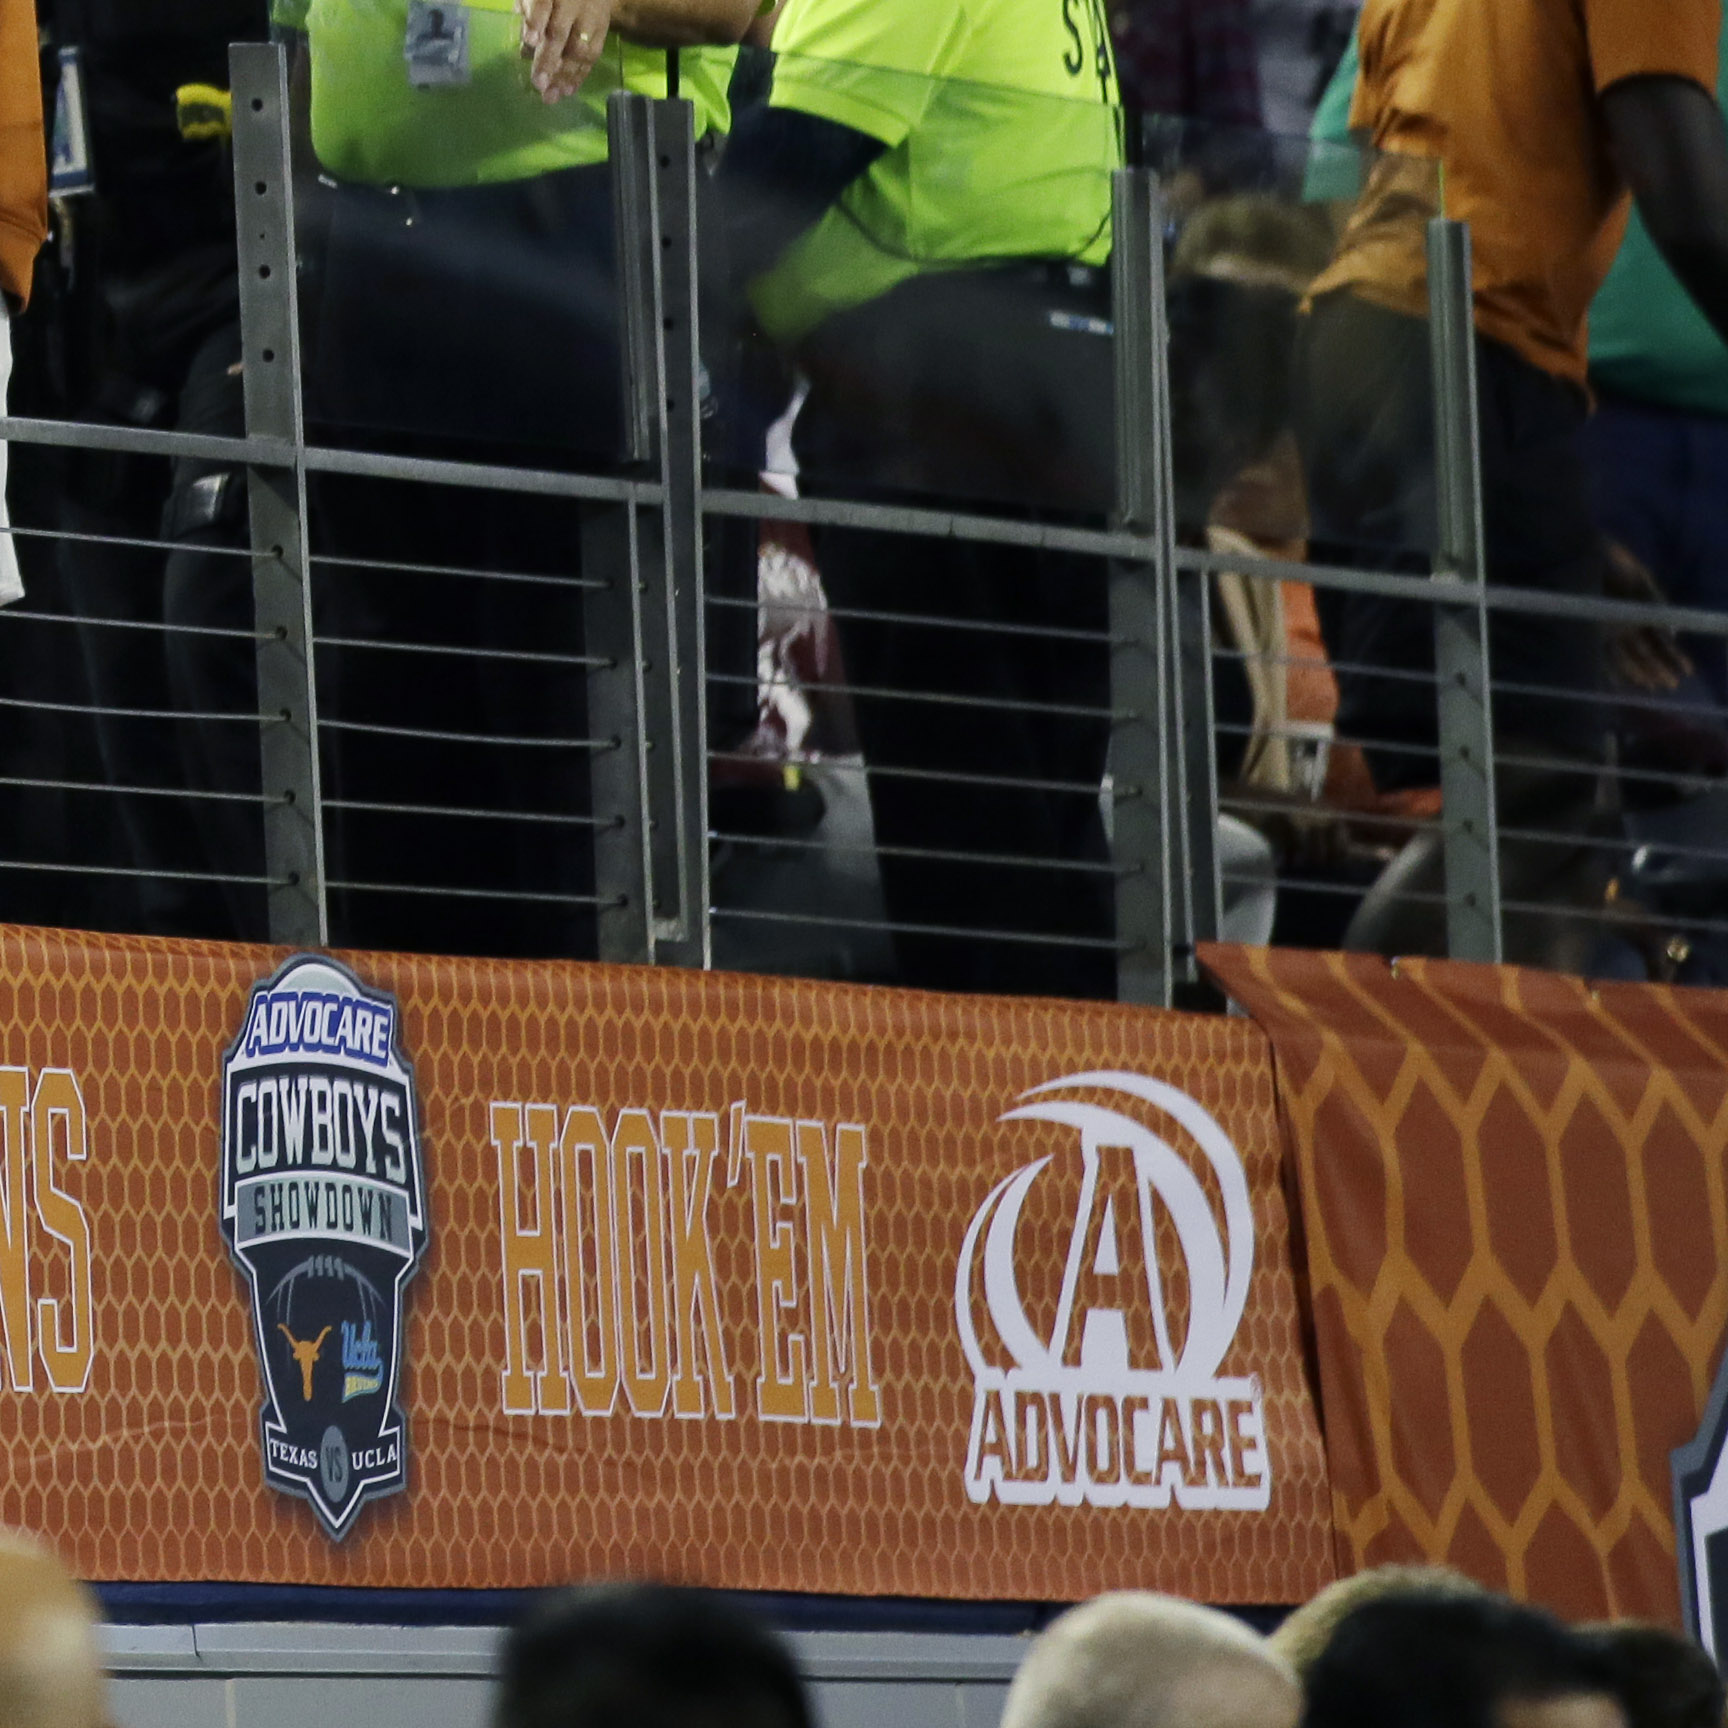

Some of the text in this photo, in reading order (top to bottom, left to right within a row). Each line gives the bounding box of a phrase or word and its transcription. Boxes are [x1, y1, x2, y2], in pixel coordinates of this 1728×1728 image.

[247, 997, 390, 1061] ADVOCARE
[235, 1074, 407, 1185] COWBOYS
[253, 1180, 393, 1242] SHOWDOWN
[489, 1099, 882, 1429] HOOK'EM
[269, 1438, 319, 1470] TEXAS
[351, 1445, 398, 1471] UCLA
[968, 1380, 1269, 1500] ADVOCARE
